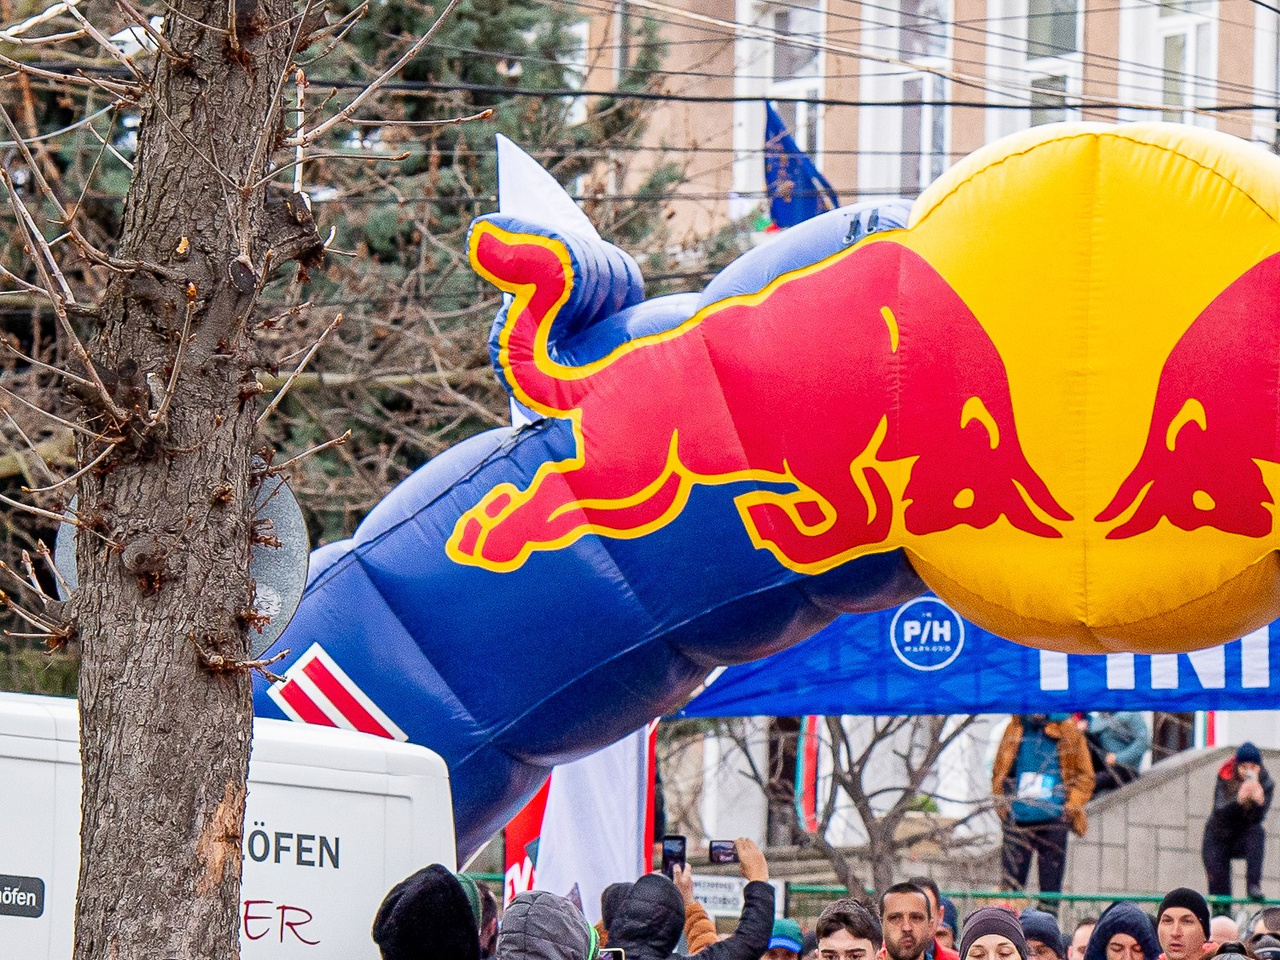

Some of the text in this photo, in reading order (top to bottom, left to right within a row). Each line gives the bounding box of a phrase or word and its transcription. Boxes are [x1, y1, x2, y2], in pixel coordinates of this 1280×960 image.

[903, 619, 951, 645] P/H
[241, 821, 340, 869] ÖFEN
[0, 886, 36, 907] öfen
